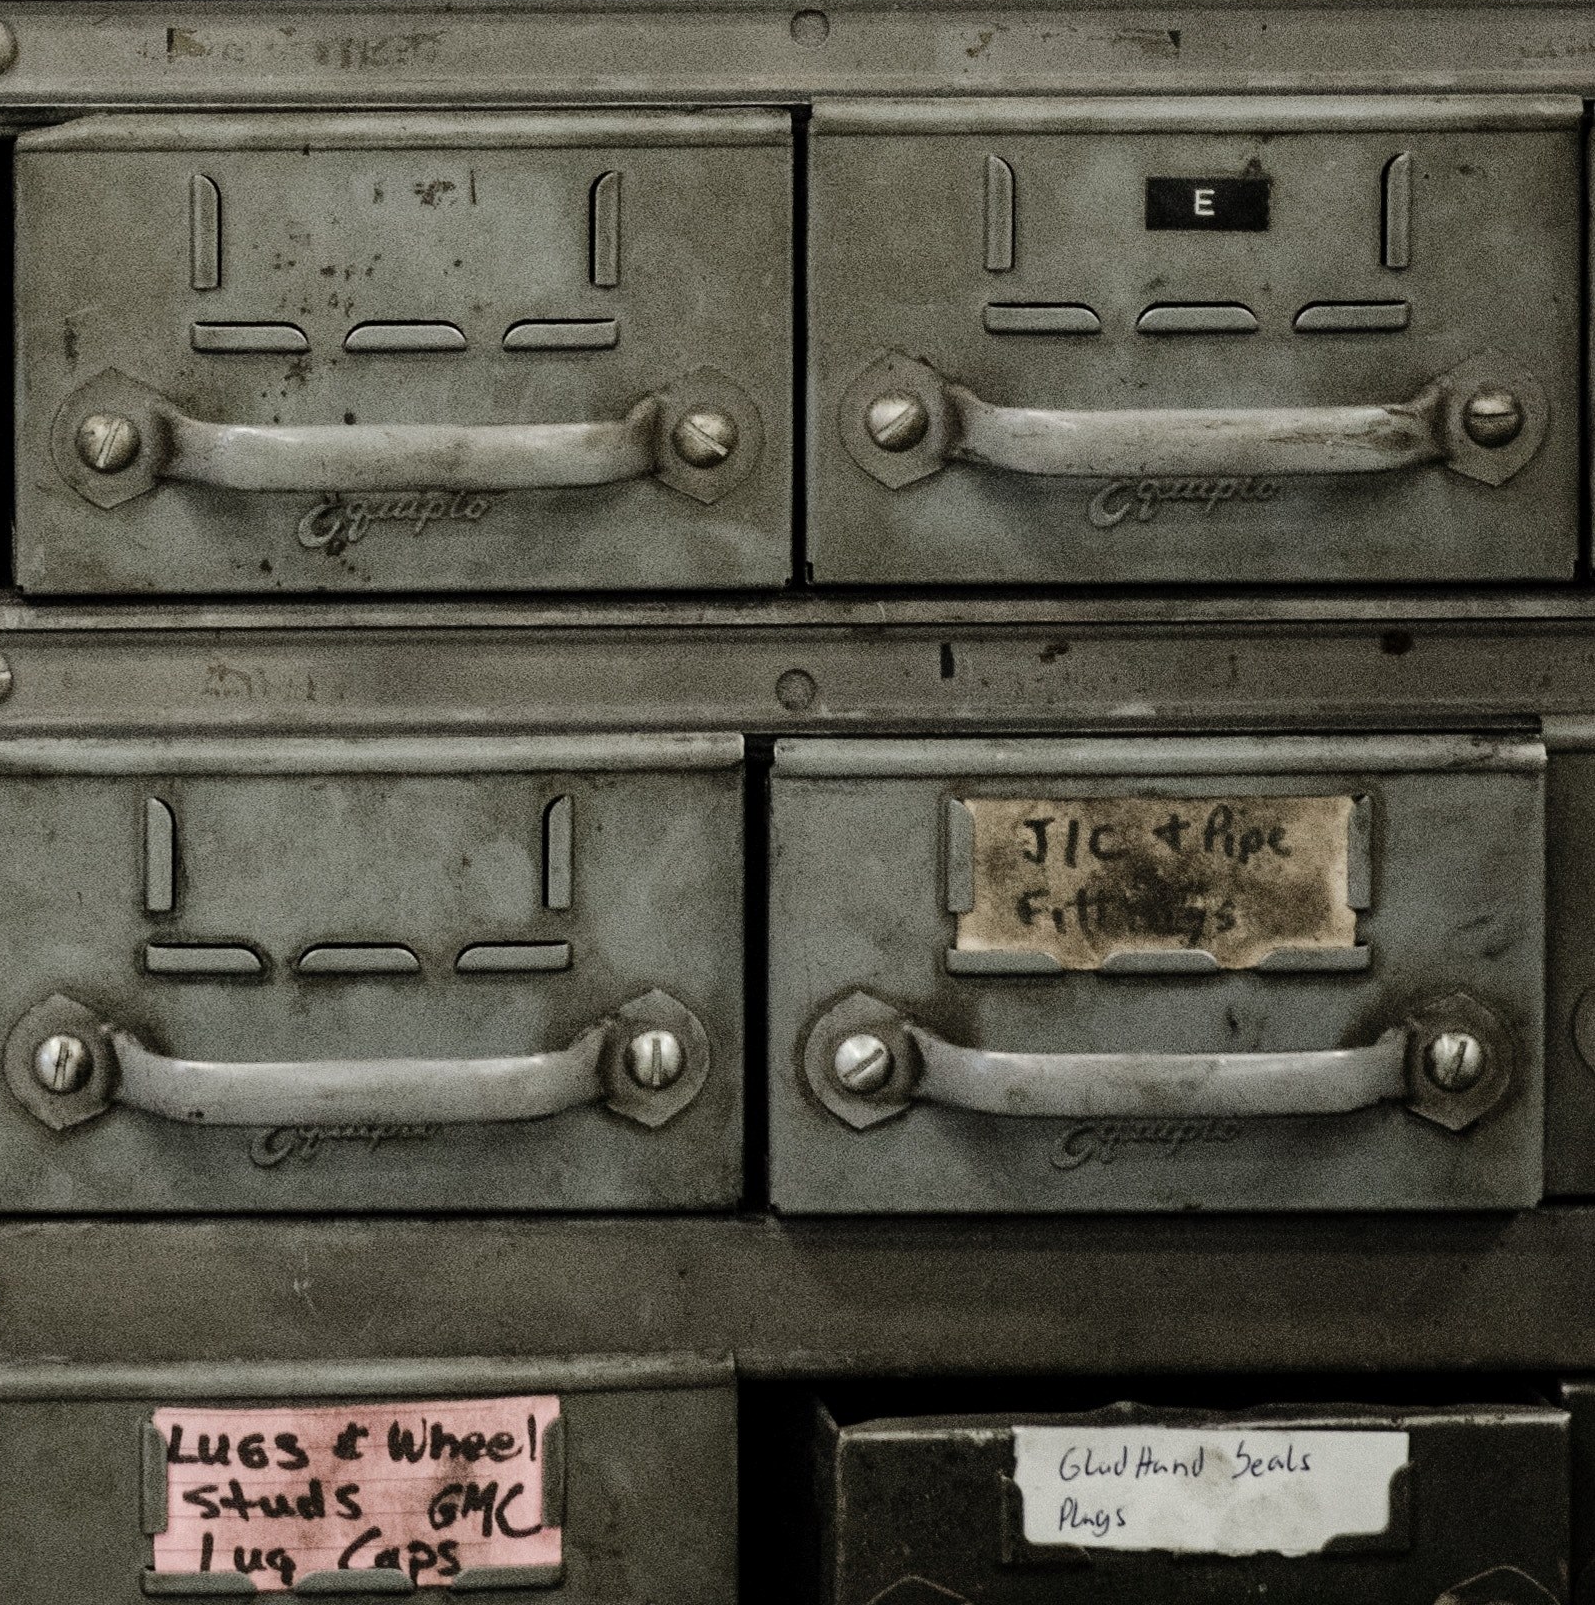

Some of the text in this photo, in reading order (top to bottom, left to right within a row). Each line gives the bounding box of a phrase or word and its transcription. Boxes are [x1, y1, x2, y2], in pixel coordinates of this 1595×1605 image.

[1193, 190, 1216, 217] E
[1207, 803, 1293, 864] Pipe
[387, 1414, 537, 1463] Wheel
[1232, 1440, 1311, 1479] Seals
[427, 1481, 543, 1538] GMC
